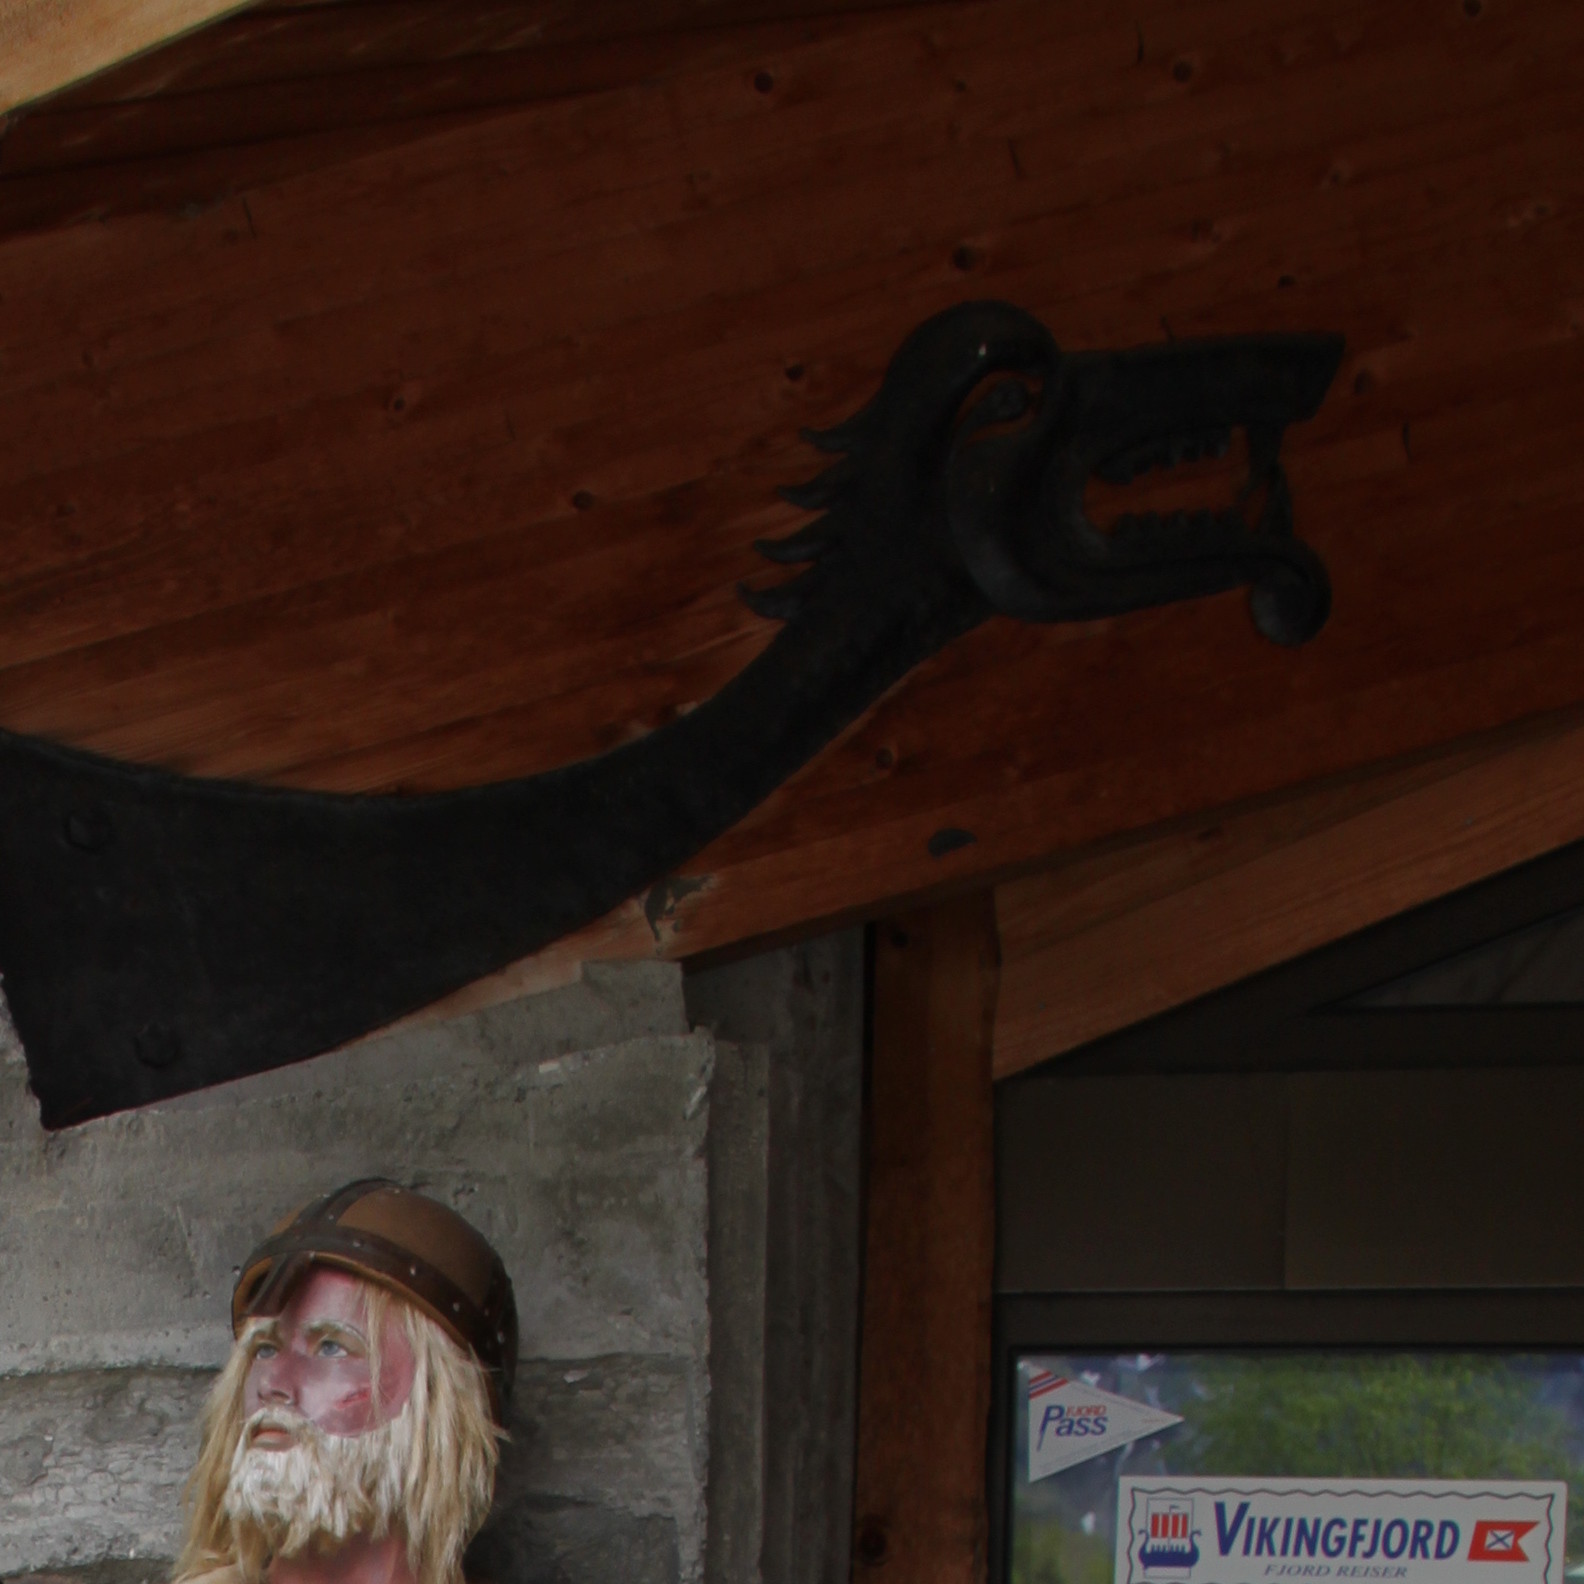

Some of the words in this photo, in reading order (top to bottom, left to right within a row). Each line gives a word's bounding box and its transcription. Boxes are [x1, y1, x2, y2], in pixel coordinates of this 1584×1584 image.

[1036, 1405, 1108, 1452] Pass
[1214, 1501, 1460, 1559] VIKINGFJORD
[1264, 1565, 1330, 1577] FJORD
[1335, 1566, 1408, 1579] REISER
